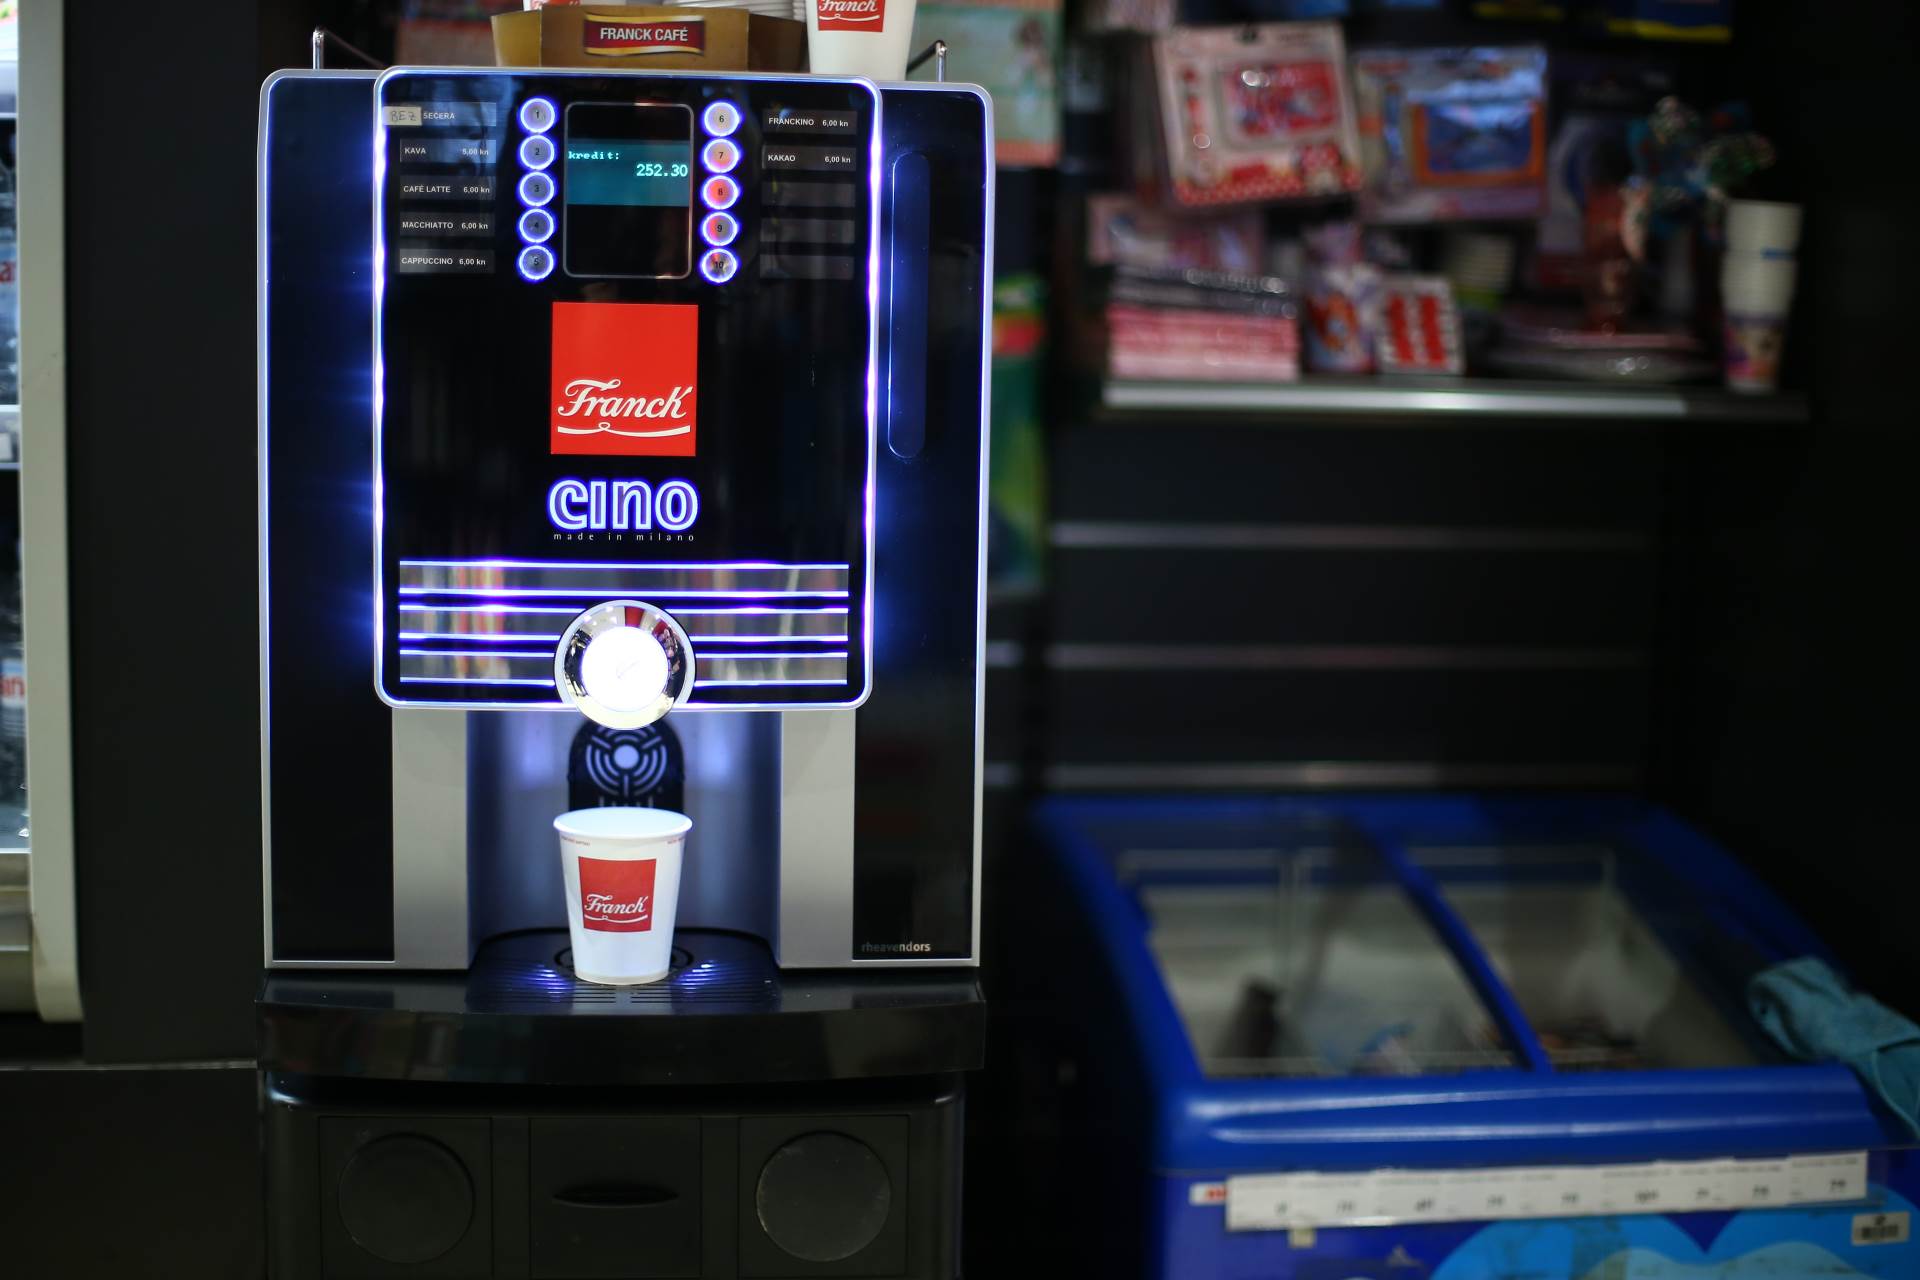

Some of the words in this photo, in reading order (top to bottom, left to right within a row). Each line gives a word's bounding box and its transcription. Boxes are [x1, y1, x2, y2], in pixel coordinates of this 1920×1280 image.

[600, 27, 652, 41] FRANCK
[654, 26, 689, 42] CAFÉ
[768, 117, 815, 126] FRANCKINO
[822, 119, 838, 127] 6,00
[839, 119, 849, 127] kn
[404, 147, 427, 155] KAVA
[479, 147, 489, 156] kn
[568, 150, 620, 160] kredit:
[767, 154, 796, 162] KAKAO
[841, 156, 851, 164] kn
[636, 163, 689, 177] 252.30
[426, 185, 451, 193] LATTE
[463, 186, 479, 194] 6,00
[402, 221, 454, 229] MACCHIATTO
[461, 222, 477, 230] 6,00
[478, 222, 489, 230] kn
[401, 257, 453, 265] CAPPUCCINO
[458, 258, 475, 266] 6,00
[476, 258, 486, 266] kn
[714, 260, 724, 269] 10
[557, 378, 693, 419] Franck
[553, 532, 594, 541] made
[608, 532, 622, 541] in
[636, 532, 694, 542] milano
[584, 893, 649, 914] Franck
[861, 940, 931, 952] rheavendors
